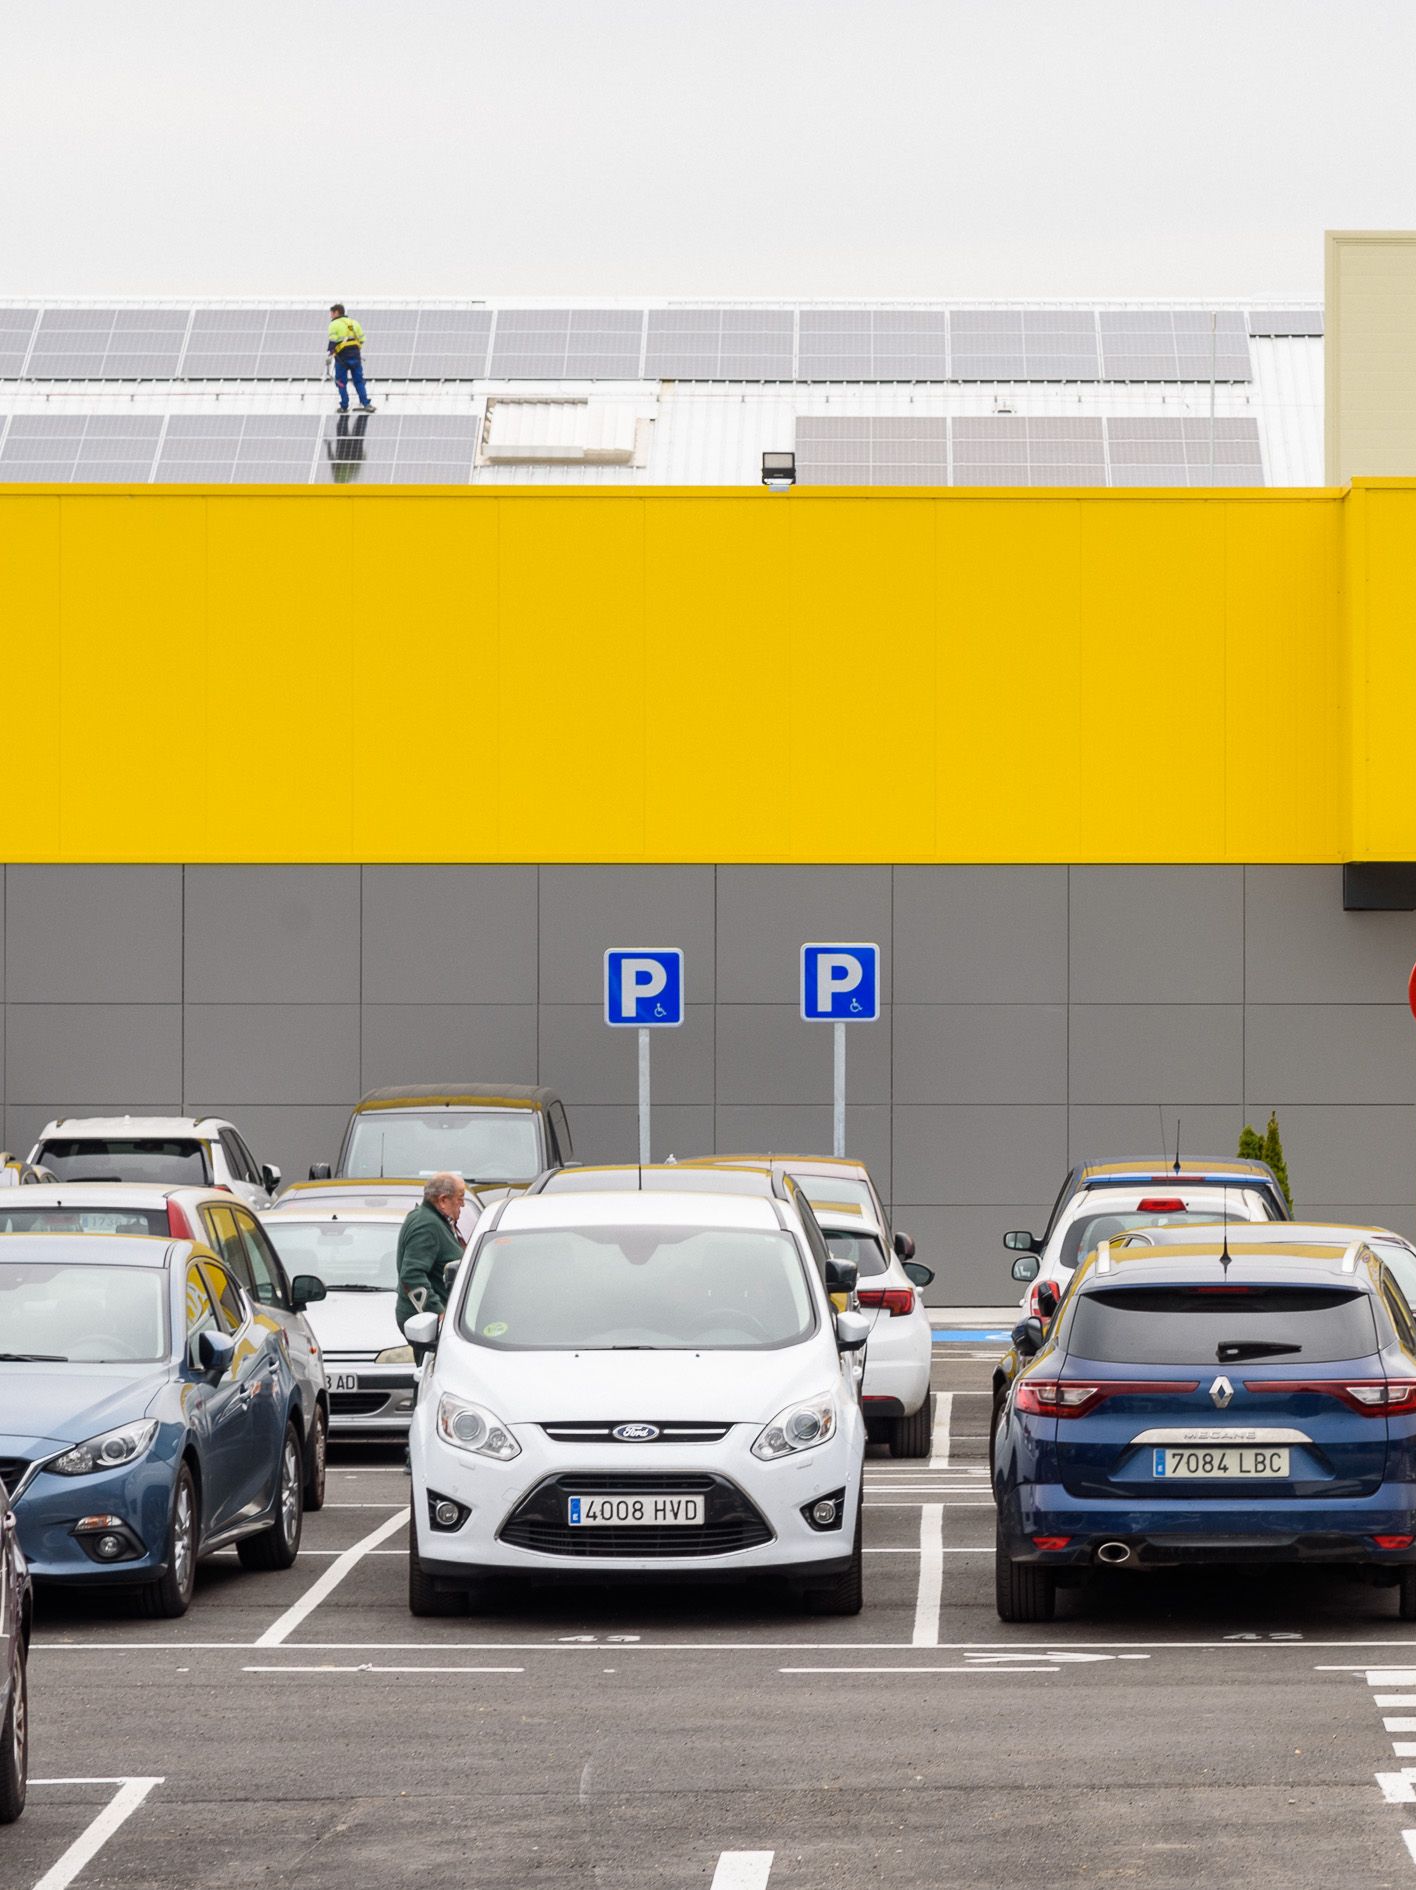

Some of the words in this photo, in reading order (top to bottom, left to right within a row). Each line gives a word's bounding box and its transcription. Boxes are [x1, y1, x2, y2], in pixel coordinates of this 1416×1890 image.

[621, 958, 667, 1017] P
[817, 953, 863, 1012] P
[336, 1375, 355, 1390] AD
[622, 1426, 650, 1437] Ford
[1171, 1453, 1229, 1473] 7084
[1239, 1453, 1281, 1473] LBC
[585, 1500, 644, 1521] 4008
[654, 1500, 697, 1521] HVD
